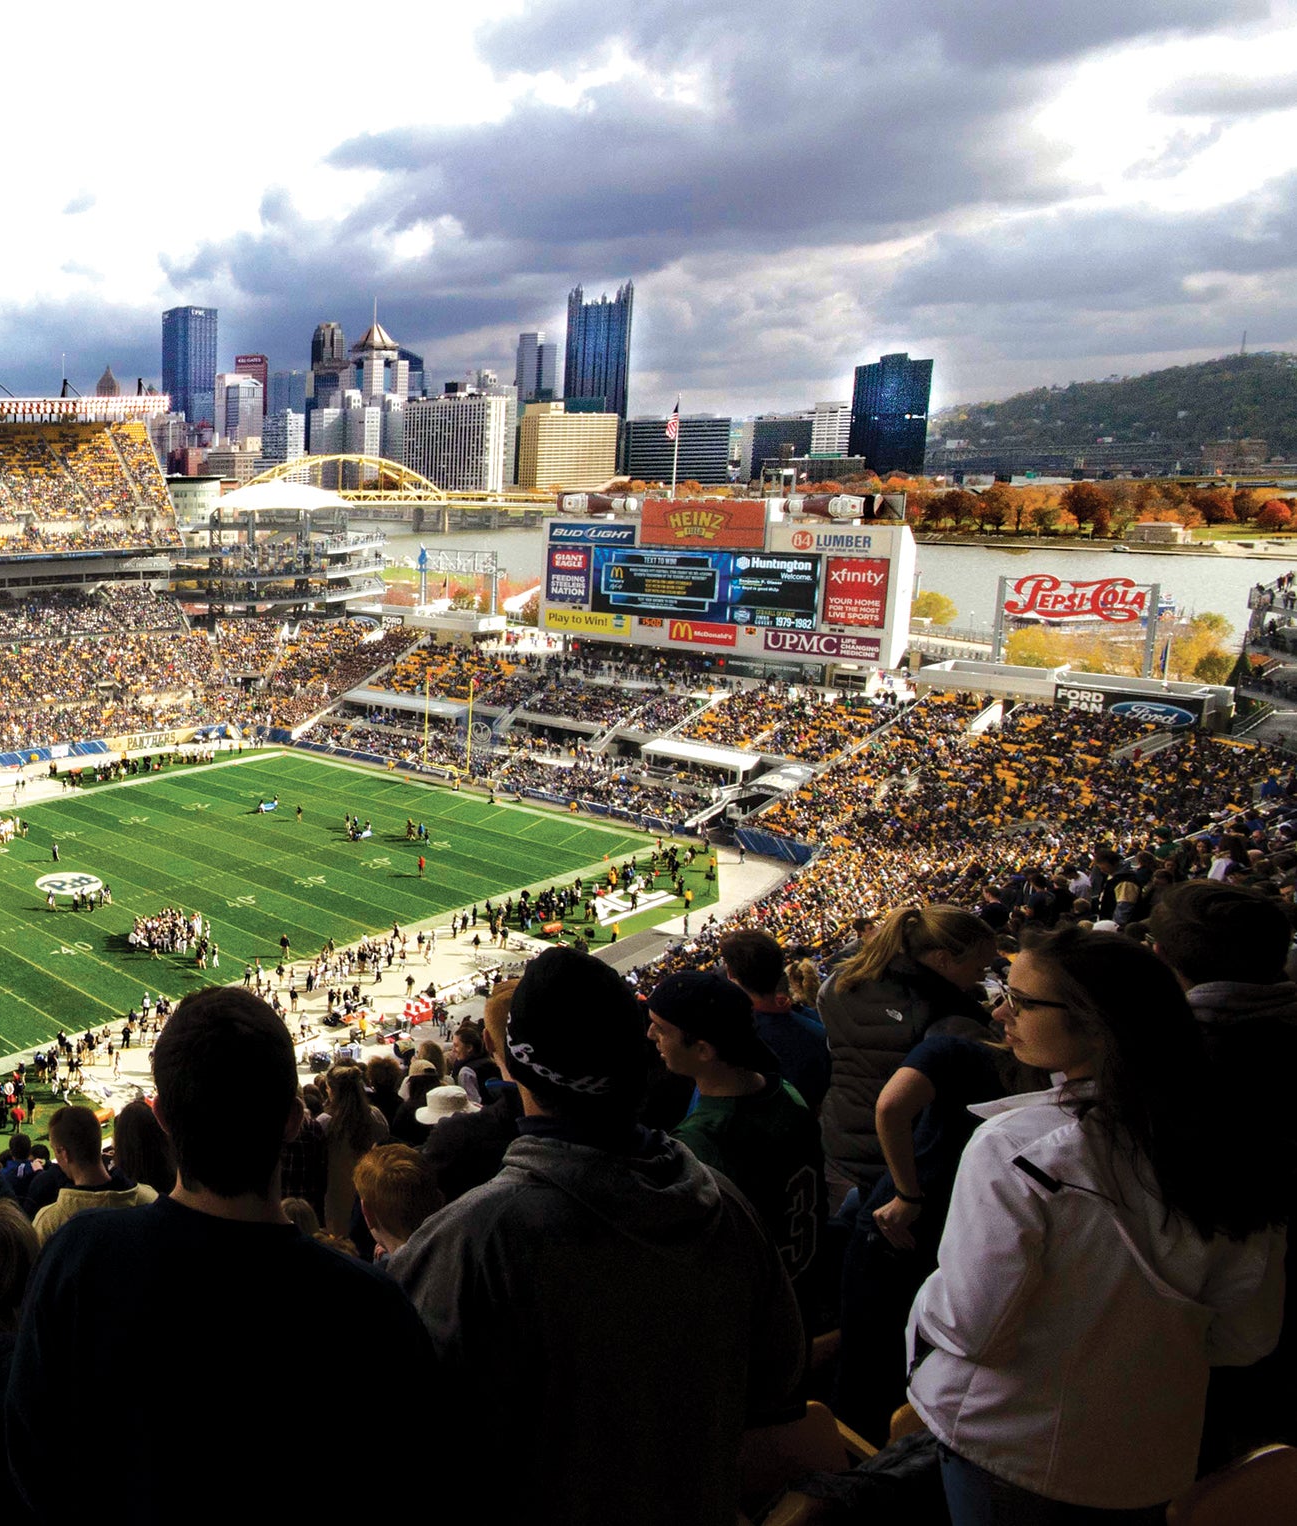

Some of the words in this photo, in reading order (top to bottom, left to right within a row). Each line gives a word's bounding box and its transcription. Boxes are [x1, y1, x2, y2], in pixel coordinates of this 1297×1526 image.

[668, 511, 725, 530] HEINZ
[793, 532, 812, 547] 84
[815, 534, 872, 548] LUMBER
[555, 553, 583, 561] GIANT
[750, 556, 812, 573] Huntington
[551, 574, 585, 582] FEEDING
[780, 572, 813, 581] Welcome.
[830, 568, 884, 586] xfinity
[550, 580, 586, 588] STEELERS
[550, 586, 585, 596] NATION
[829, 597, 853, 605] YOUR
[854, 599, 881, 607] HOME
[381, 615, 403, 625] FORD
[548, 612, 569, 625] Play
[571, 614, 582, 624] to
[584, 614, 608, 627] Win!
[775, 616, 812, 629] 1979-1982
[847, 613, 880, 621] SPORTS
[693, 630, 733, 640] McDonald's
[766, 631, 838, 654] UPMC
[840, 644, 880, 652] CHANGING
[840, 650, 876, 658] MEDICINE
[1056, 688, 1104, 703] FORD
[1068, 701, 1103, 714] FAN
[1124, 703, 1177, 725] Ford
[126, 731, 177, 751] PANTHERS
[40, 874, 100, 892] Pitt
